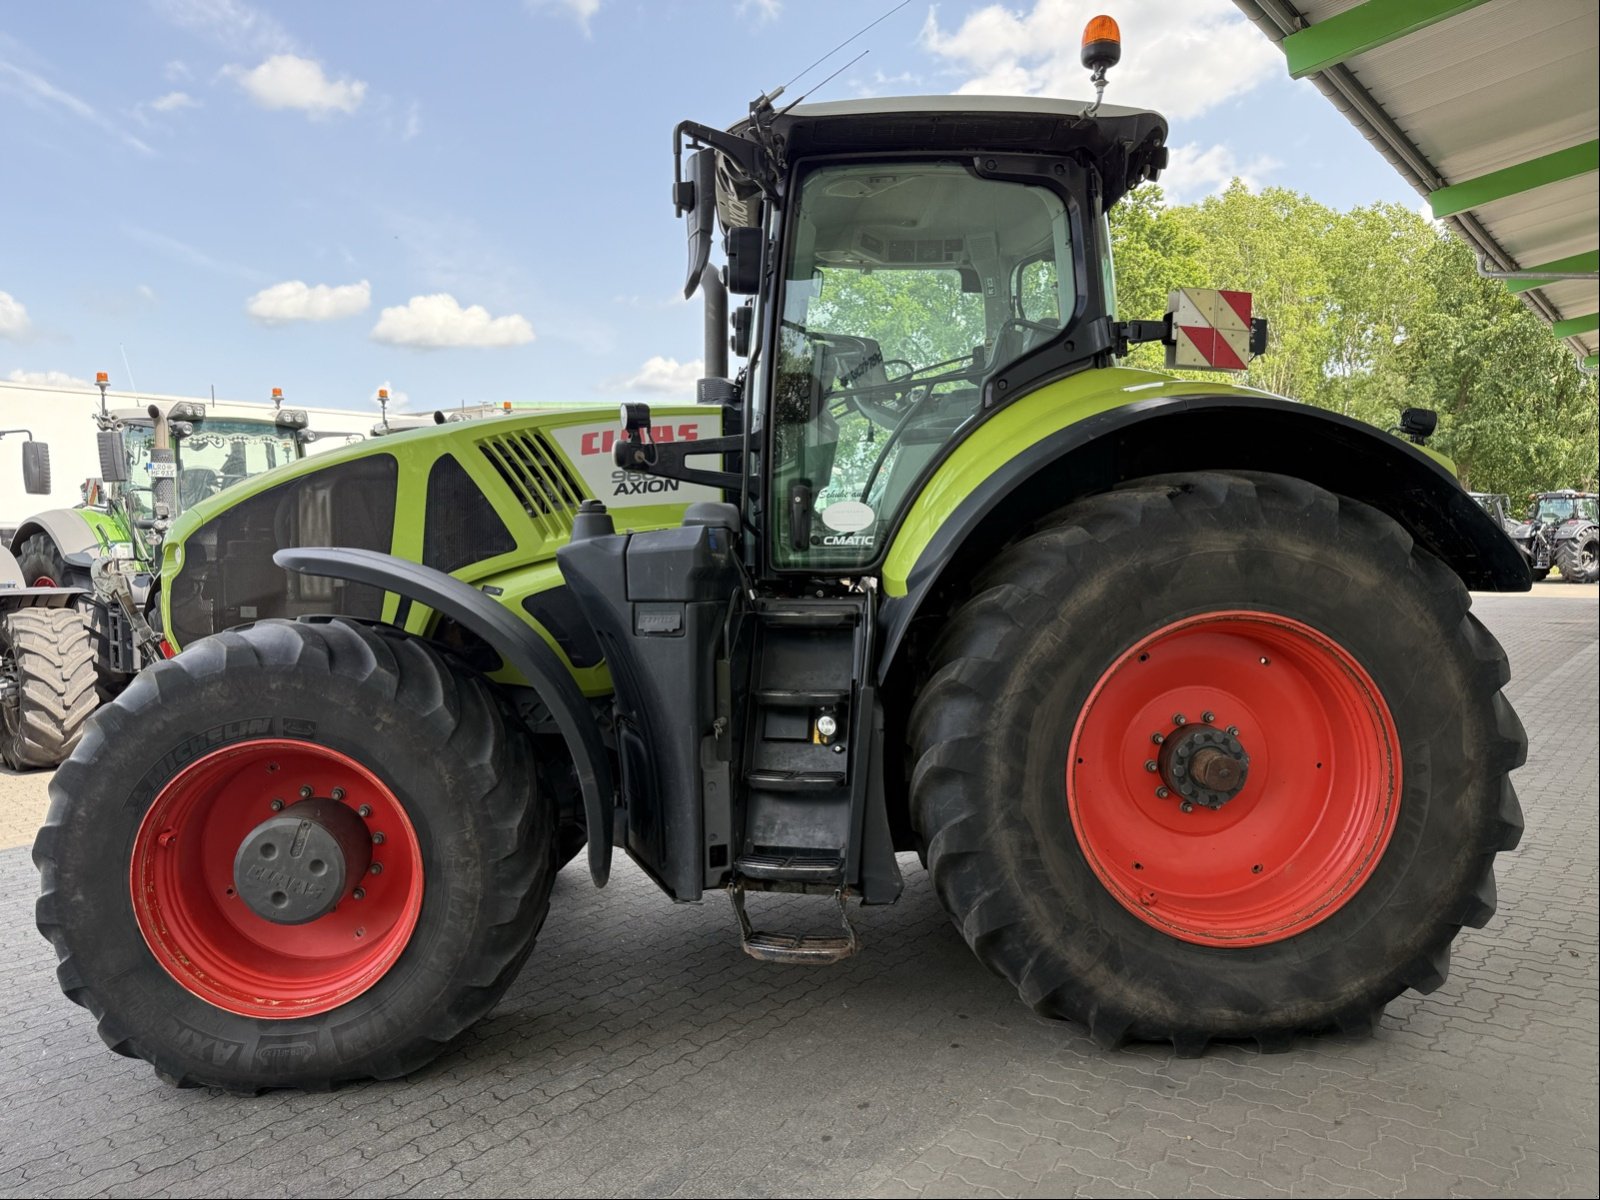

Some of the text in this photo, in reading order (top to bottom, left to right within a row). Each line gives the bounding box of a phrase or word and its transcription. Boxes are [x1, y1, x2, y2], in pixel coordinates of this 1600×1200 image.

[613, 479, 680, 496] AXION
[823, 536, 875, 545] CMATIC
[149, 716, 275, 789] MICHELIN
